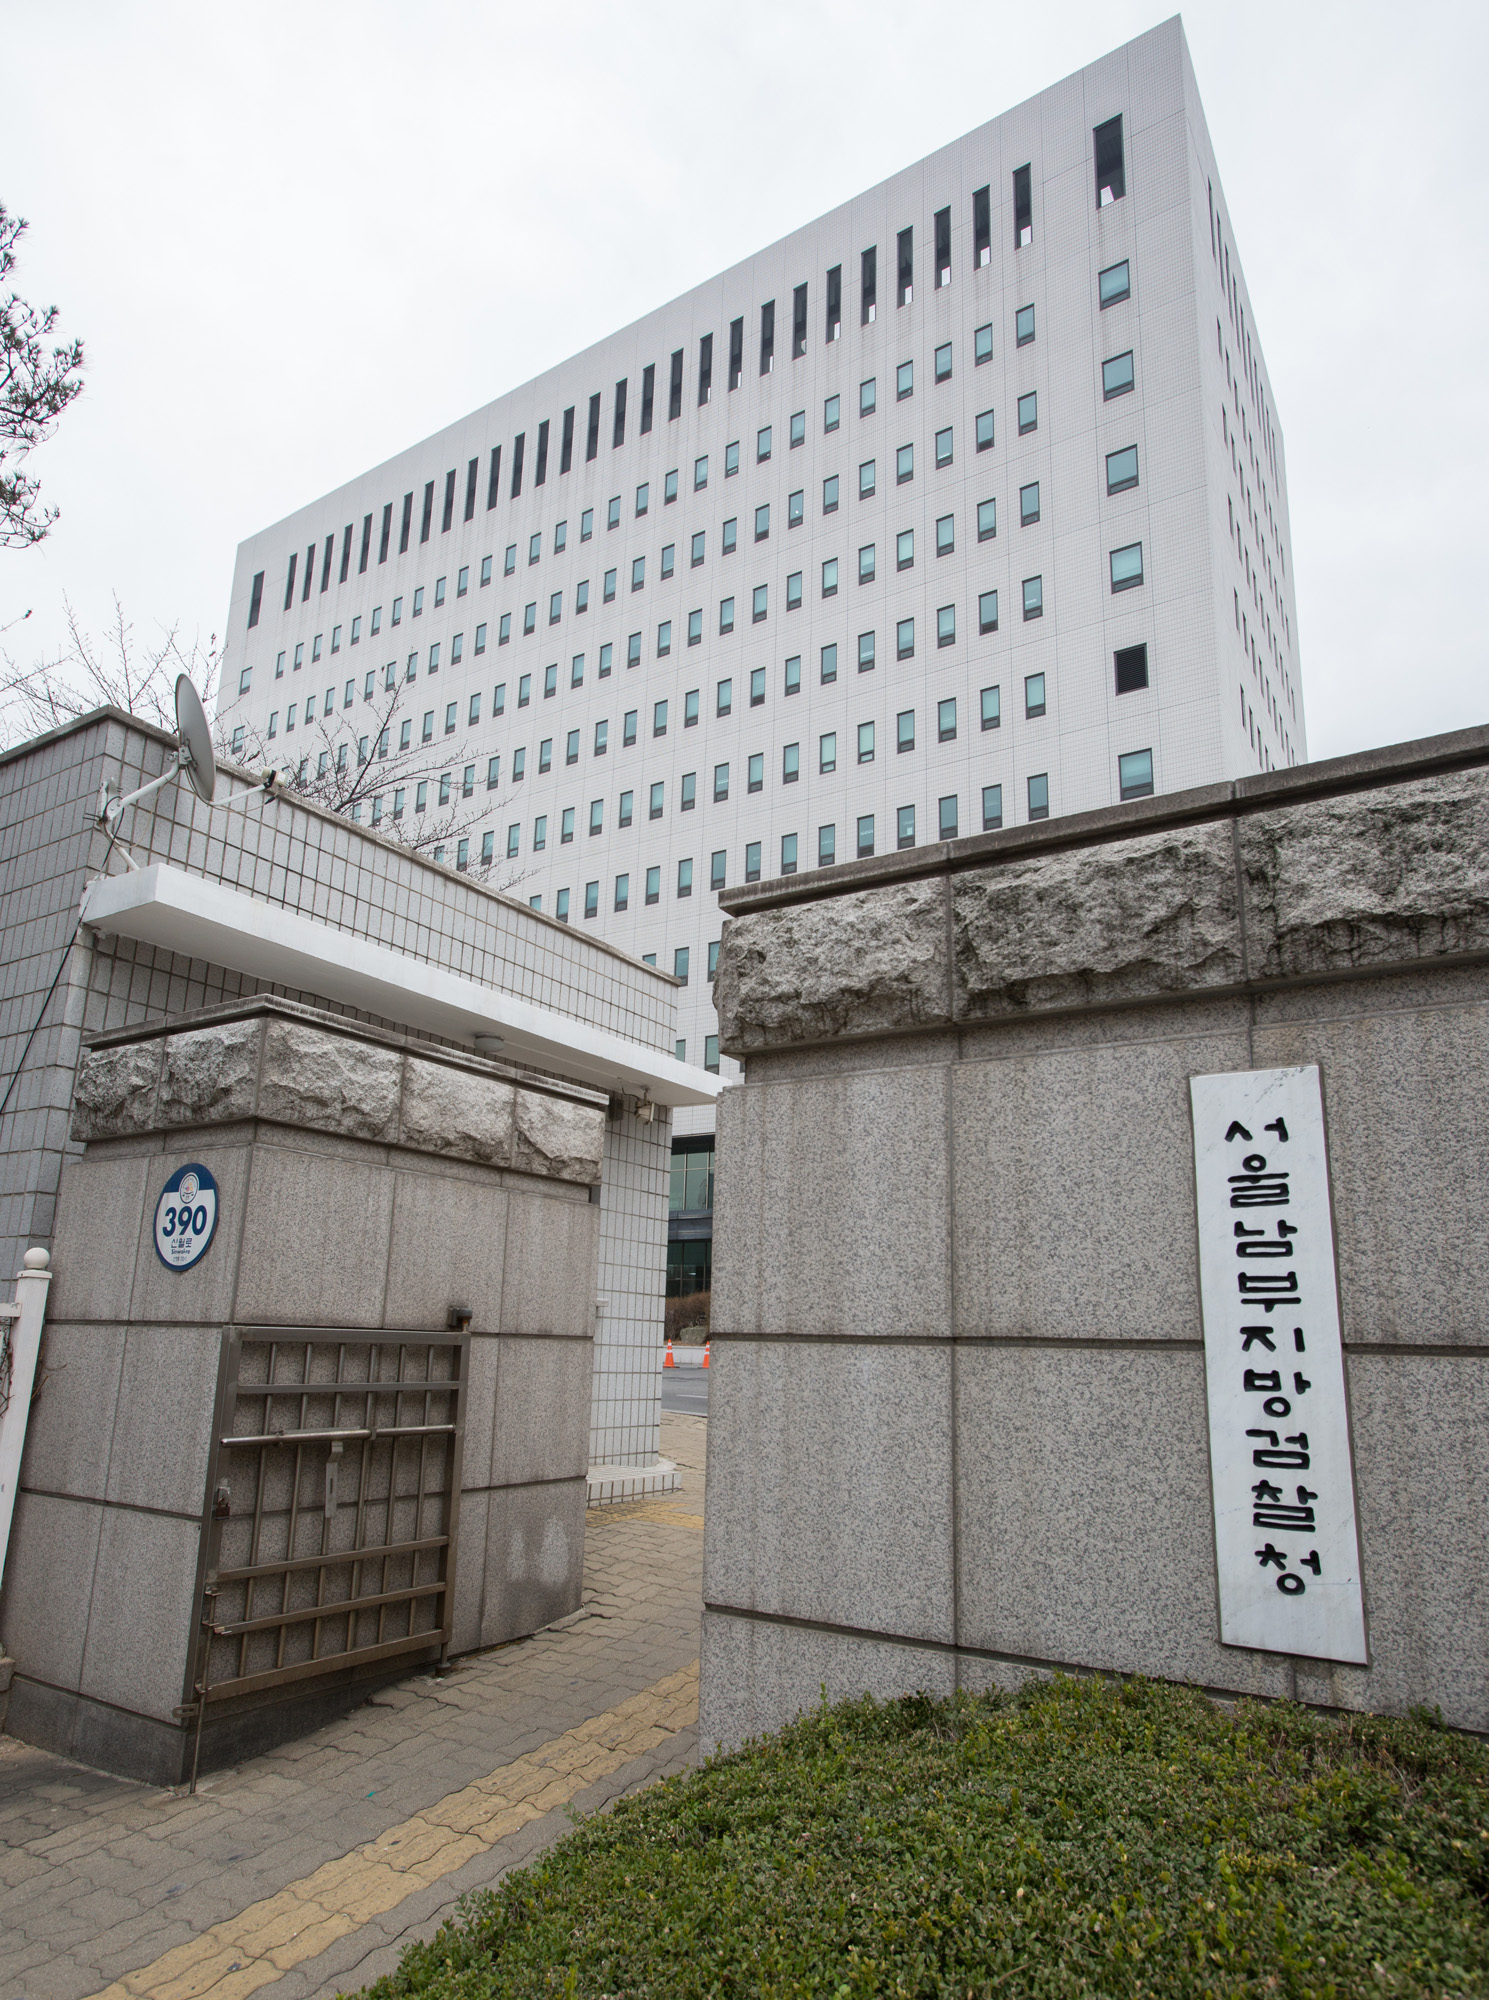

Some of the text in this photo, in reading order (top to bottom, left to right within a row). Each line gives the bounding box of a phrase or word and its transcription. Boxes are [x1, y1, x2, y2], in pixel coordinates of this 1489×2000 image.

[162, 1205, 207, 1237] 390
[171, 1238, 192, 1249] 신월로
[1224, 1117, 1321, 1596] 서울남부지방검찰청
